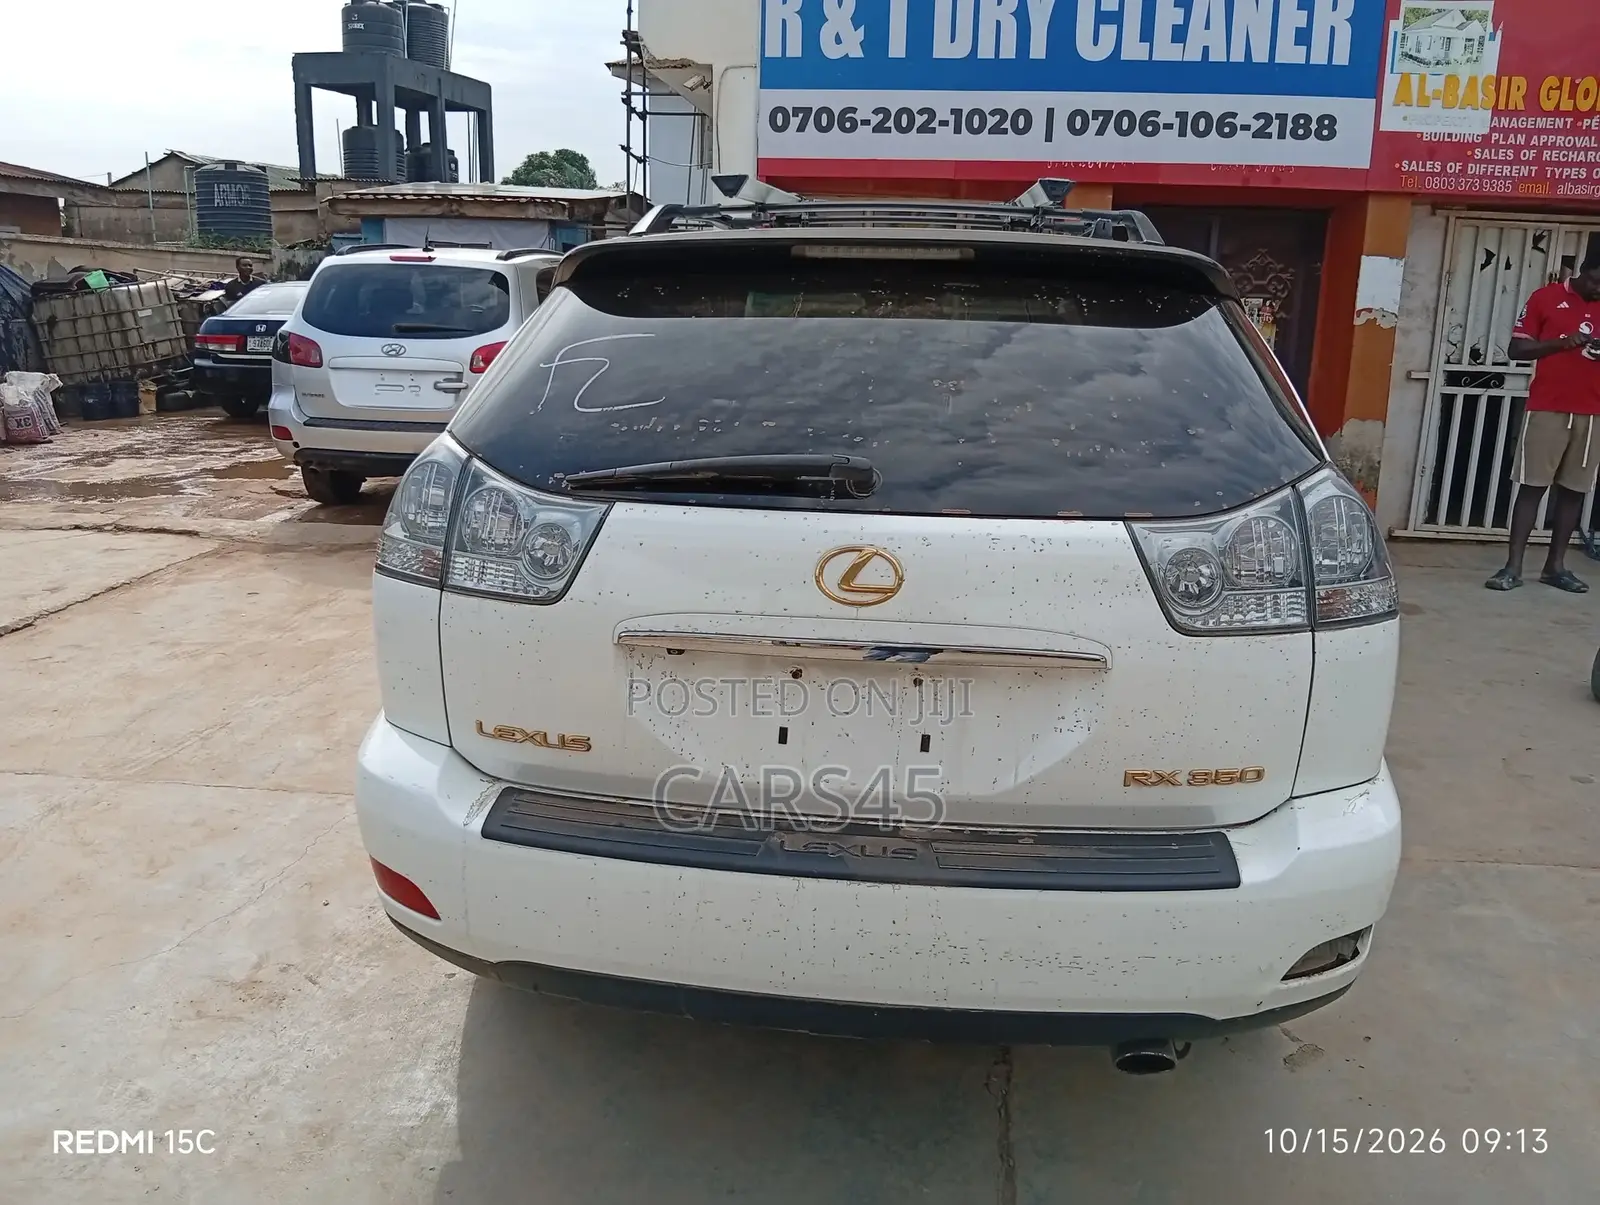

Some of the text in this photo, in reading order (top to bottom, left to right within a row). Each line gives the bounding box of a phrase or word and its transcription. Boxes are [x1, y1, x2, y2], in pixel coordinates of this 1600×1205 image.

[932, 0, 1056, 59] DRY
[1075, 0, 1355, 66] CLEANER
[1392, 72, 1600, 112] AL-BASIR GLO
[768, 105, 1033, 136] 0706-202-1020
[1066, 108, 1338, 142] 0706-106-2188
[1489, 115, 1575, 130] ANAGEMENT
[1422, 131, 1598, 148] BUILDING PLAN APPROVAL
[1474, 148, 1515, 161] SALES
[1520, 149, 1538, 161] OF
[1401, 160, 1442, 173] SALES
[1446, 162, 1464, 174] OF
[1467, 163, 1539, 178] DIFFERENT
[1545, 166, 1588, 180] TYPES
[1401, 174, 1422, 189] Tel.
[1425, 176, 1455, 190] 0803
[1457, 178, 1481, 192] 373
[1482, 179, 1513, 193] 9385
[475, 719, 592, 752] LEXUS
[1123, 765, 1266, 788] RX 350
